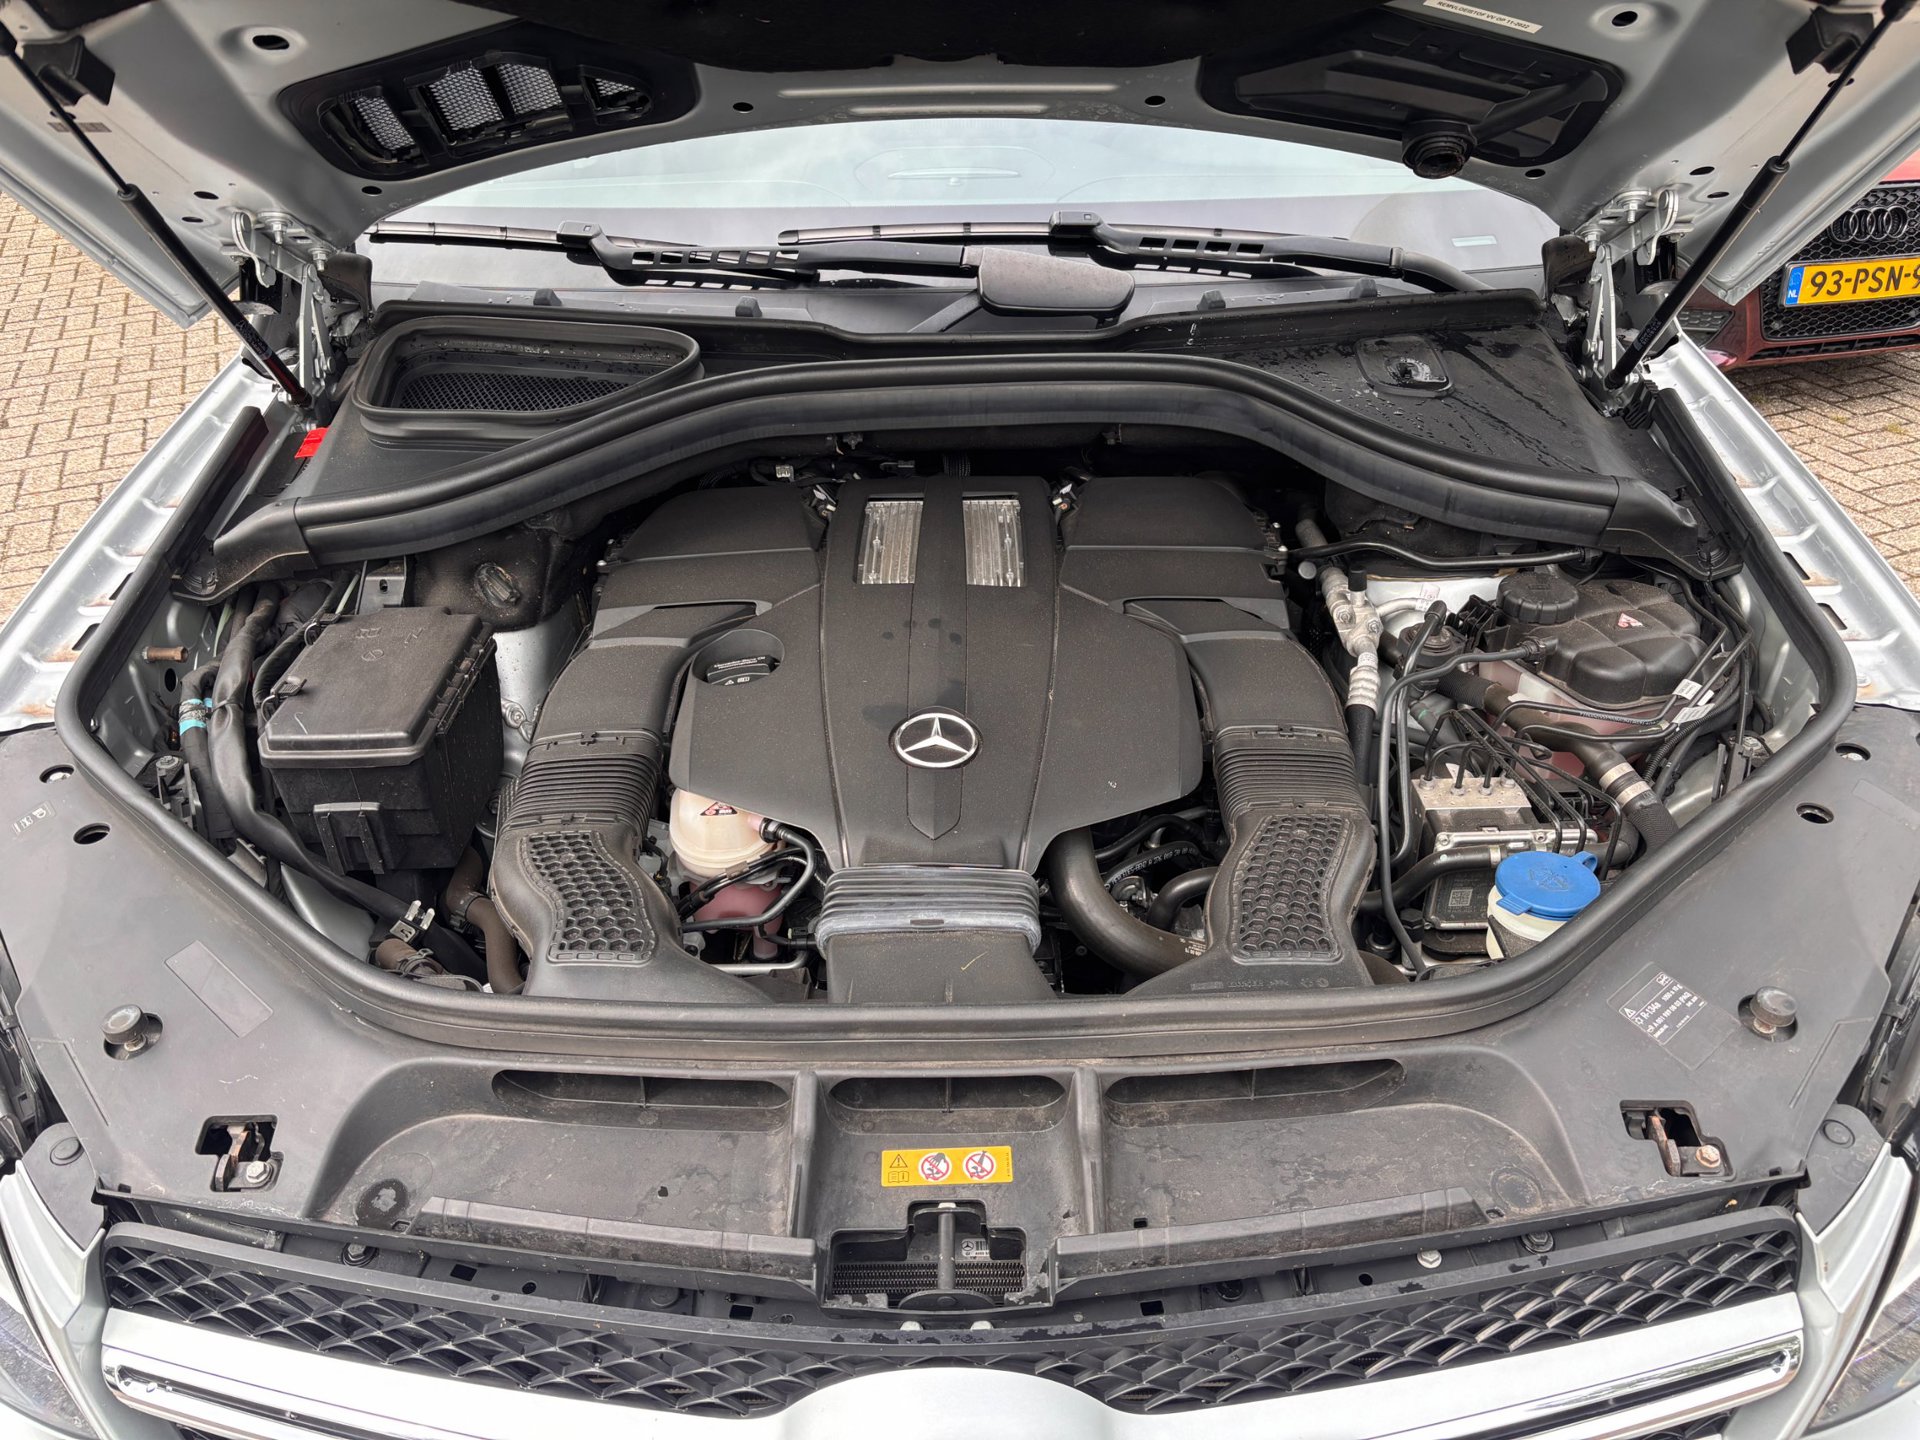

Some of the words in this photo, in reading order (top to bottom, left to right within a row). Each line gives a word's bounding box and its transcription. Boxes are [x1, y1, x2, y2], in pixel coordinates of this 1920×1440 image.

[1437, 1, 1486, 17] REMVLOEISTOF
[1787, 289, 1798, 298] NL
[1640, 1002, 1661, 1019] R-134a
